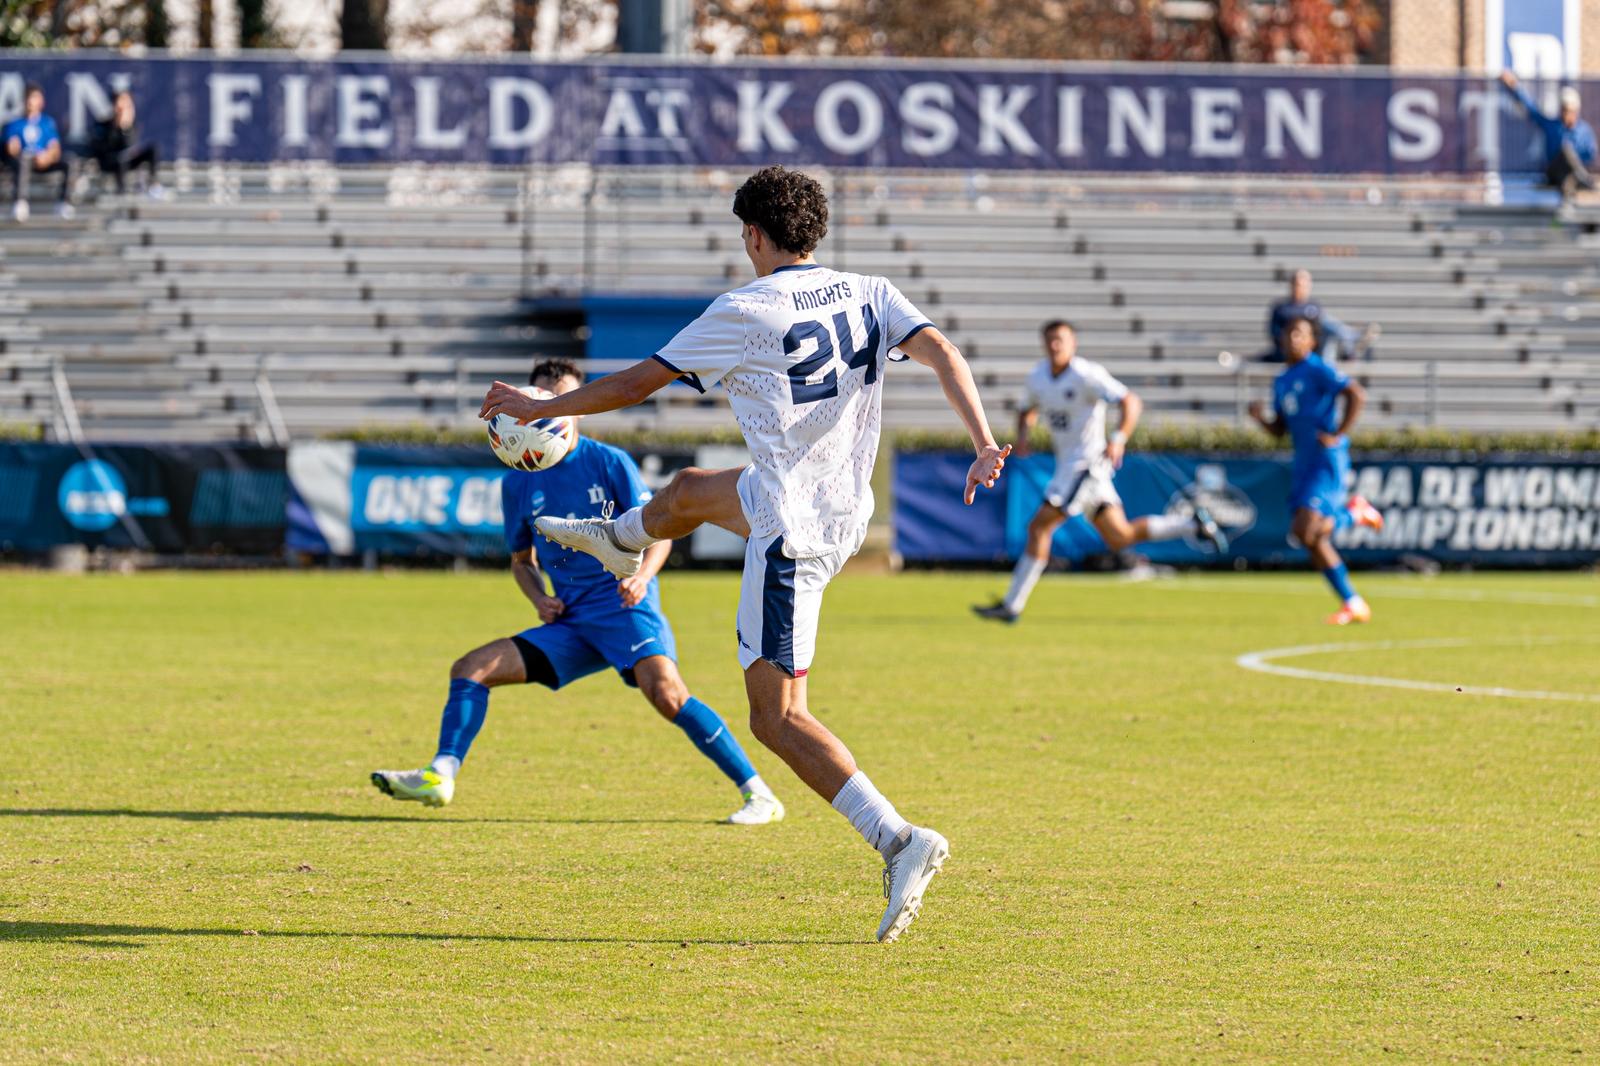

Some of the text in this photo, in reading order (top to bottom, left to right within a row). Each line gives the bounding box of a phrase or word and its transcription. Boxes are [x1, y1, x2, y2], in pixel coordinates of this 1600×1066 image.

[207, 73, 555, 149] FIELD
[601, 87, 692, 137] AT
[735, 79, 1324, 160] KOSKINEN
[792, 281, 852, 311] KNIGHTS
[782, 303, 881, 405] 24
[364, 475, 453, 525] ONE
[1344, 466, 1600, 509] AA DI WOM
[1286, 506, 1600, 551] MPIONSH
